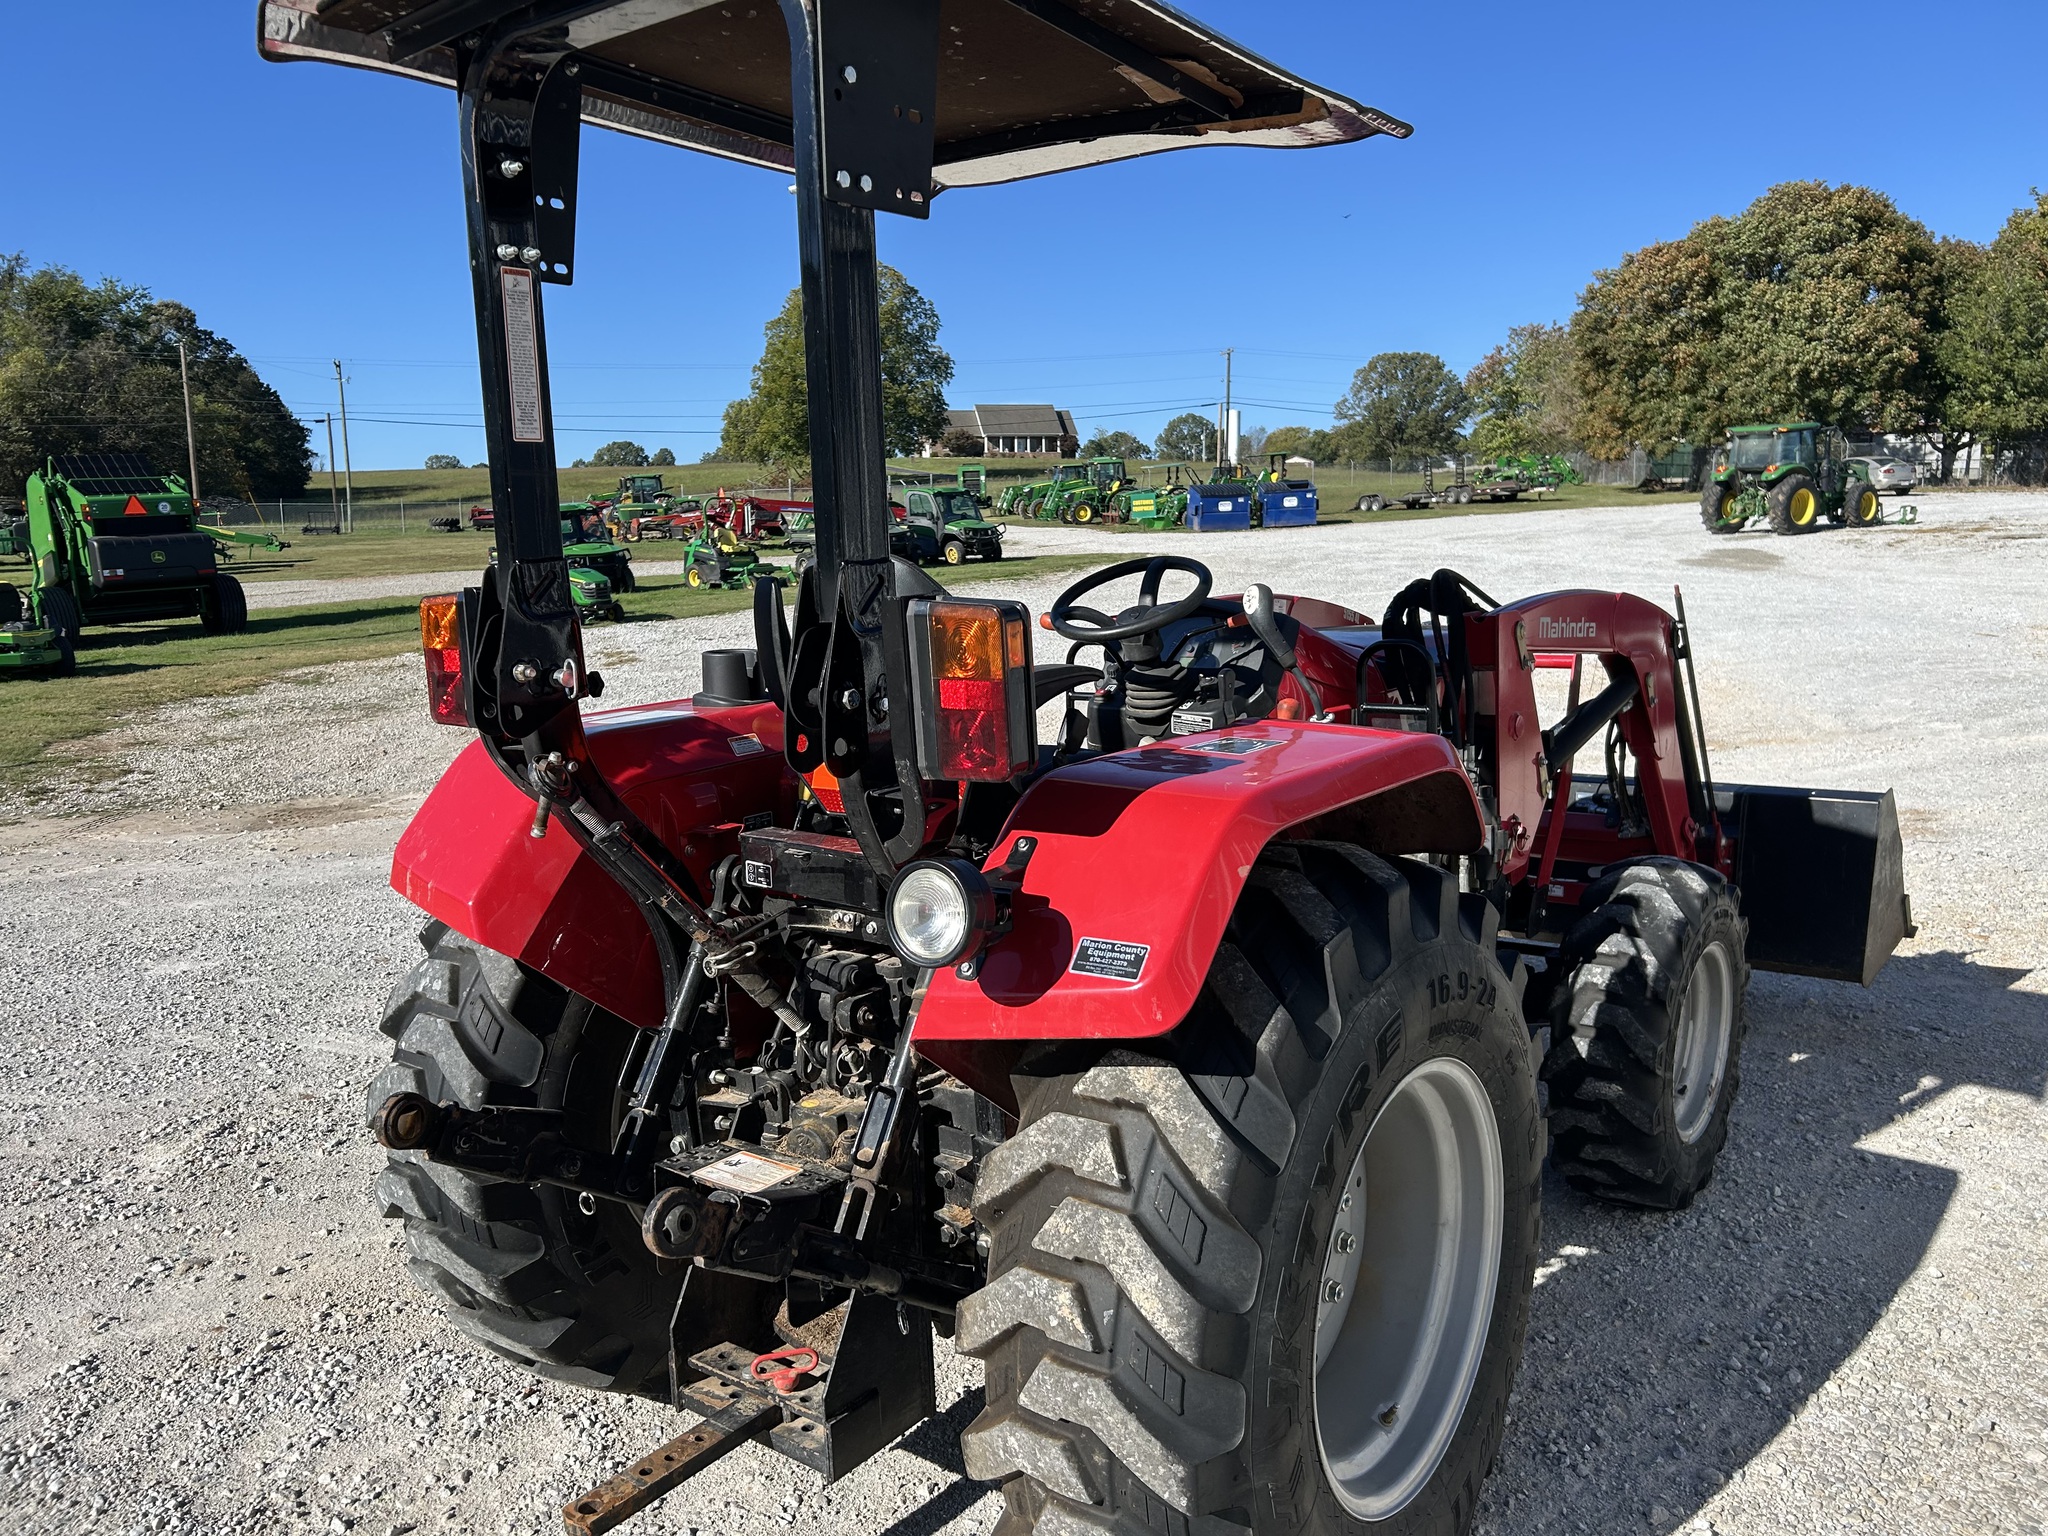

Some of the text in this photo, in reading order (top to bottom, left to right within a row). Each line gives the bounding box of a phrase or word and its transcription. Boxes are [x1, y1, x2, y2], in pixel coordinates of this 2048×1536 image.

[1539, 617, 1596, 638] Mahindra
[1082, 939, 1146, 956] Marion County
[1087, 947, 1136, 961] Equipment
[1426, 971, 1497, 1013] 16.9-24
